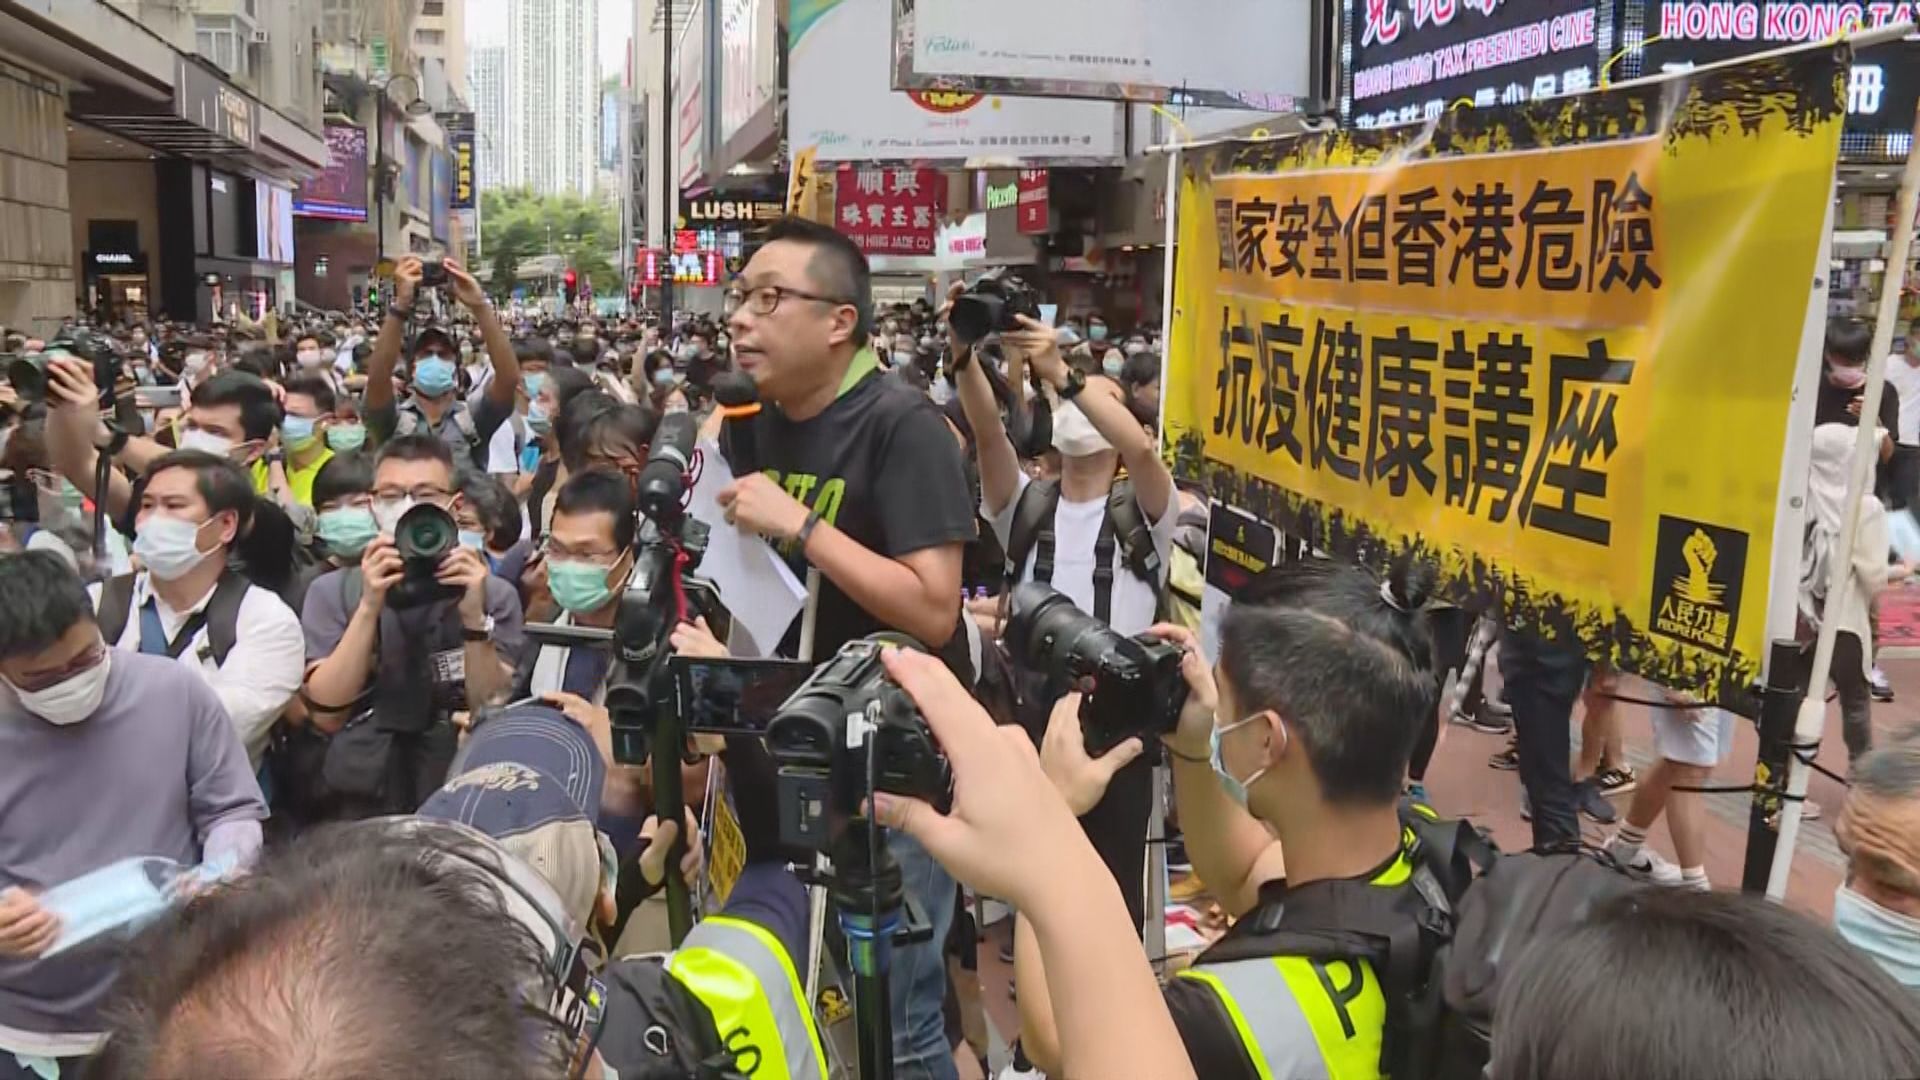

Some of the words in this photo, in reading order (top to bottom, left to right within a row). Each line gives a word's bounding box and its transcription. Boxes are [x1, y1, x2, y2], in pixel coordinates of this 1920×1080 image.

[1661, 1, 1758, 41] HONG
[1764, 2, 1863, 42] KONG
[1354, 64, 1392, 99] HONG
[1392, 52, 1433, 89] KONG
[1434, 40, 1466, 80] TAX
[690, 201, 753, 220] LUSH
[1216, 169, 1664, 295] 國家安全但香港危險
[95, 253, 133, 263] CHANEL
[1212, 305, 1636, 547] 抗疫健康講座
